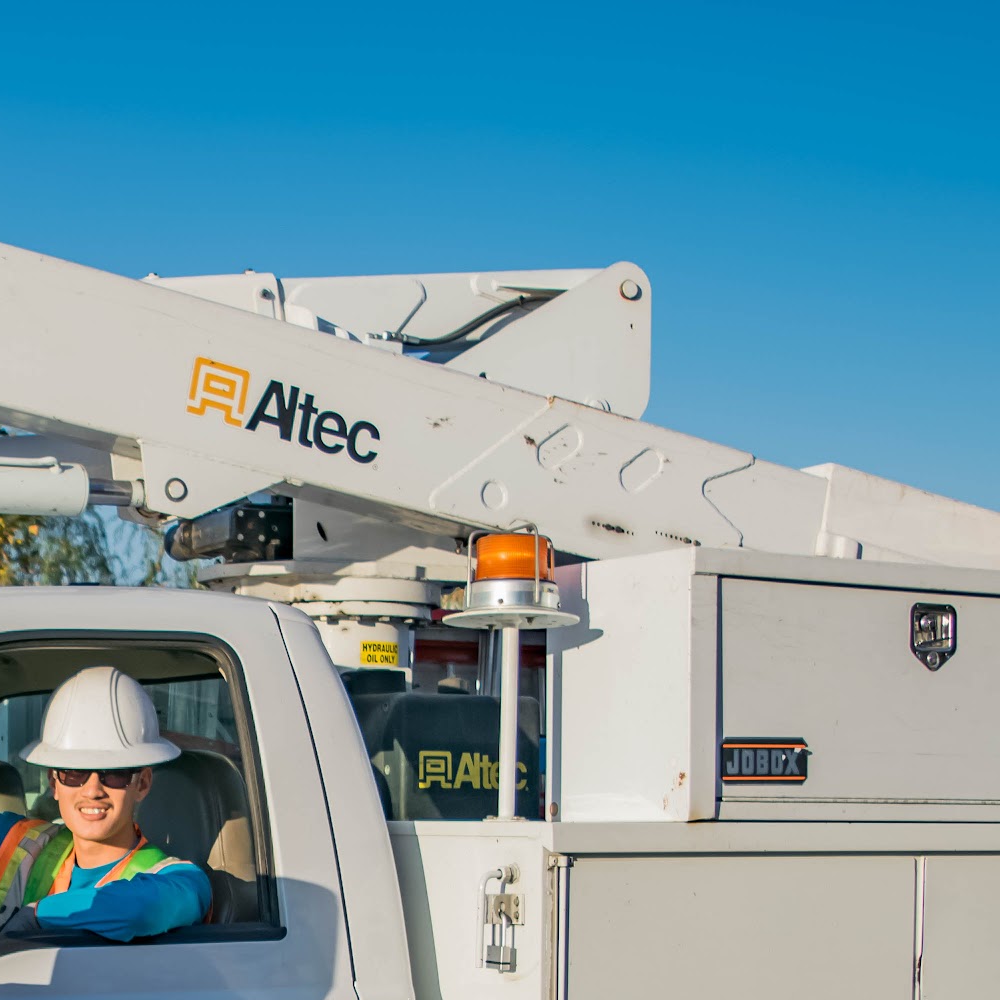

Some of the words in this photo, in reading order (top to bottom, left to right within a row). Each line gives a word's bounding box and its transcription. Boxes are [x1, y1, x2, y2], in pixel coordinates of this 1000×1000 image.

[245, 379, 381, 464] Altec
[362, 643, 397, 653] HYDRAULIC
[367, 654, 378, 663] OIL
[380, 655, 395, 664] ONLY
[726, 749, 800, 775] JOBOX
